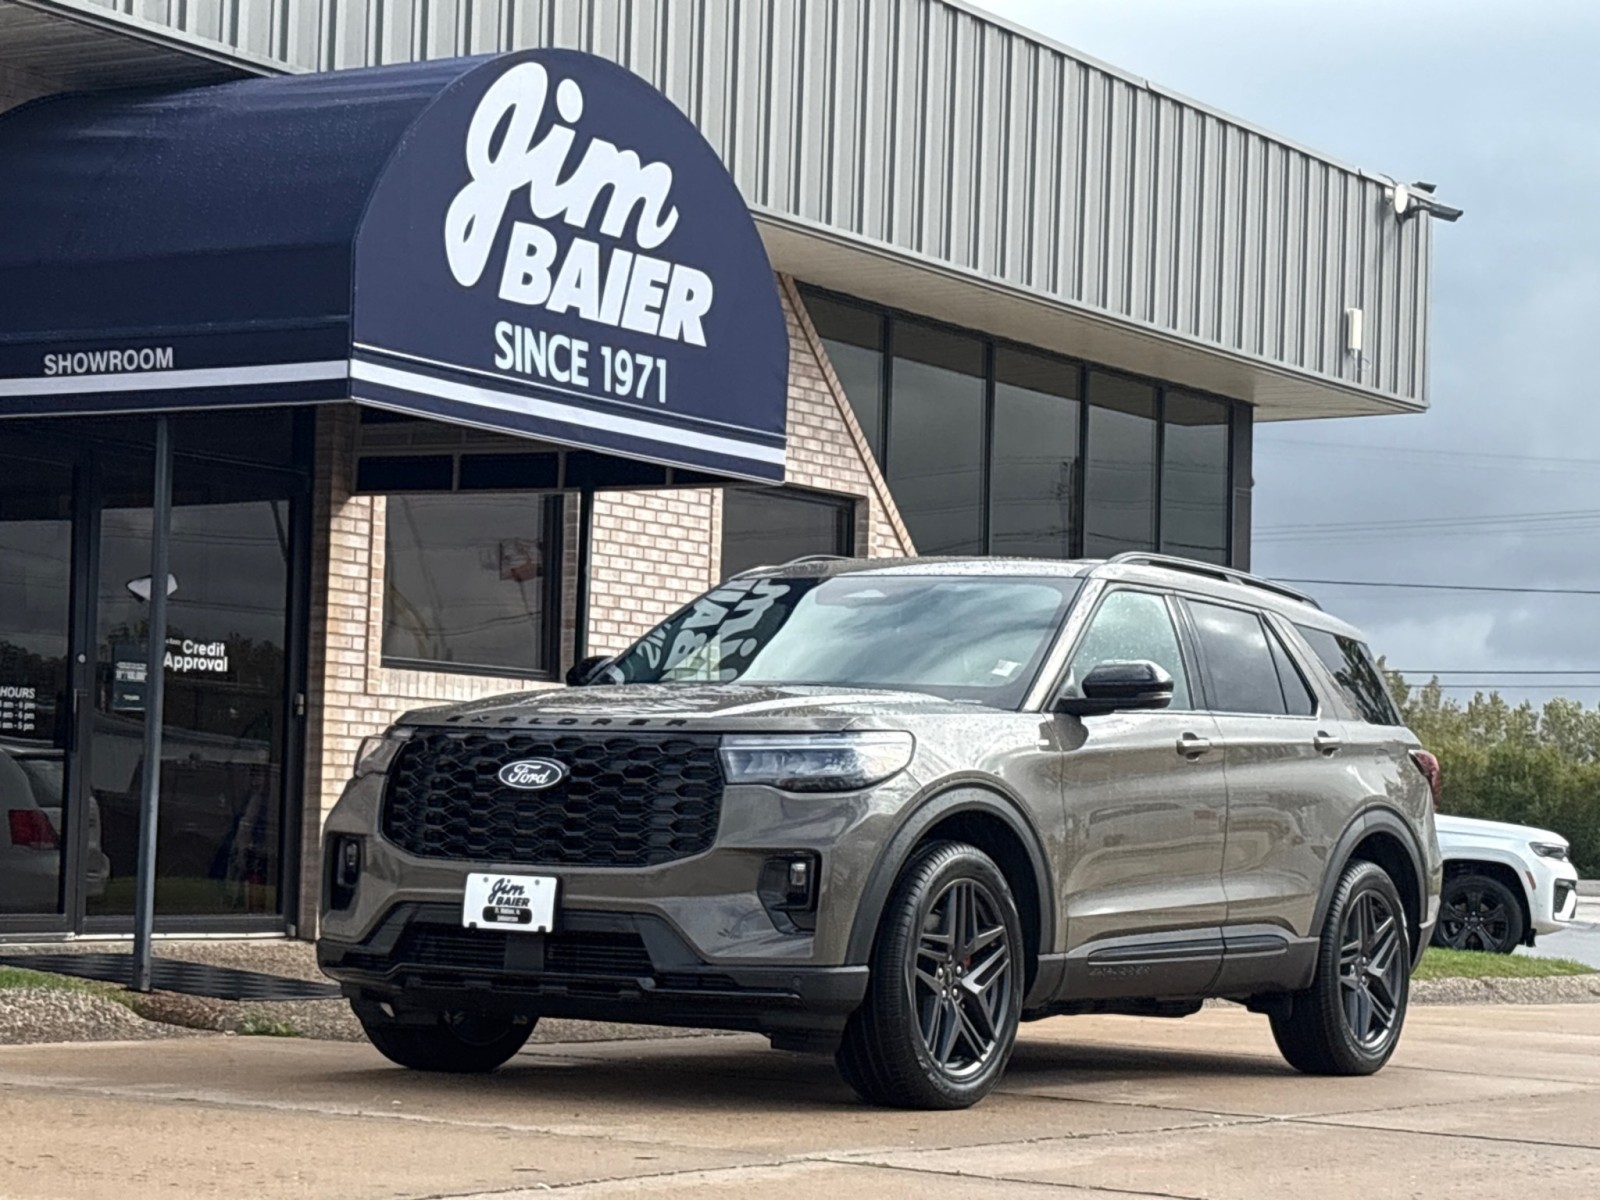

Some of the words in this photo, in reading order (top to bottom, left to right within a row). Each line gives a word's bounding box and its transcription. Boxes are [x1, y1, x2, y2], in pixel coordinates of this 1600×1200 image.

[444, 61, 679, 287] Jim
[498, 220, 713, 348] BAIER
[43, 346, 174, 376] SHOWROOM
[494, 320, 589, 387] SINCE
[600, 345, 667, 404] 1971
[182, 639, 225, 657] Credit
[163, 651, 228, 673] Approval
[0, 686, 36, 699] HOURS
[508, 763, 551, 783] Ford
[487, 877, 525, 905] Jim
[496, 896, 530, 907] BAIER
